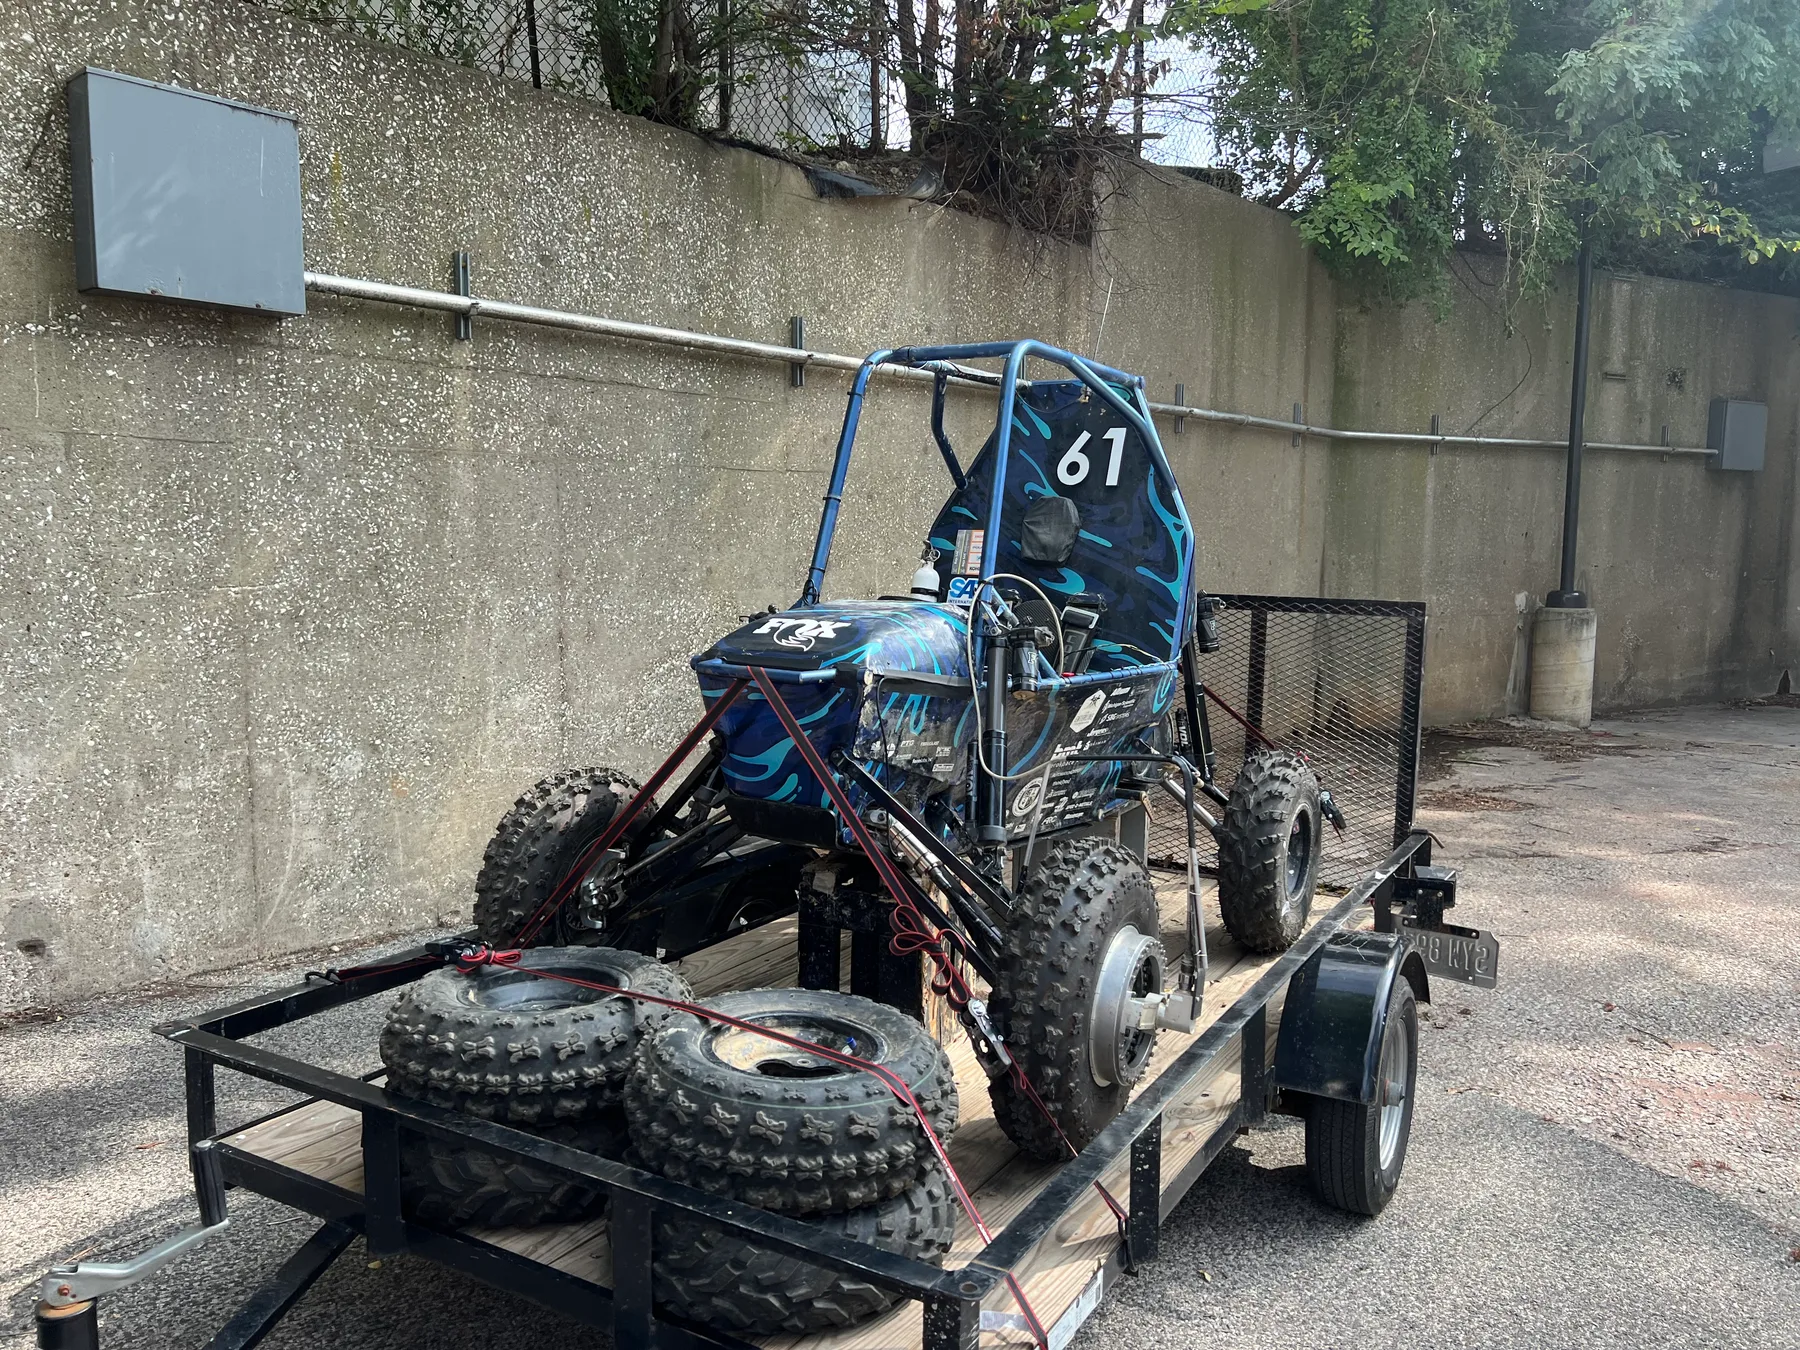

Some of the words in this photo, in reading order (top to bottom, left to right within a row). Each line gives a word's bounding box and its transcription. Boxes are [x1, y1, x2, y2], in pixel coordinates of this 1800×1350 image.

[1057, 427, 1127, 486] 61
[950, 578, 977, 599] SA
[752, 618, 851, 651] FOX
